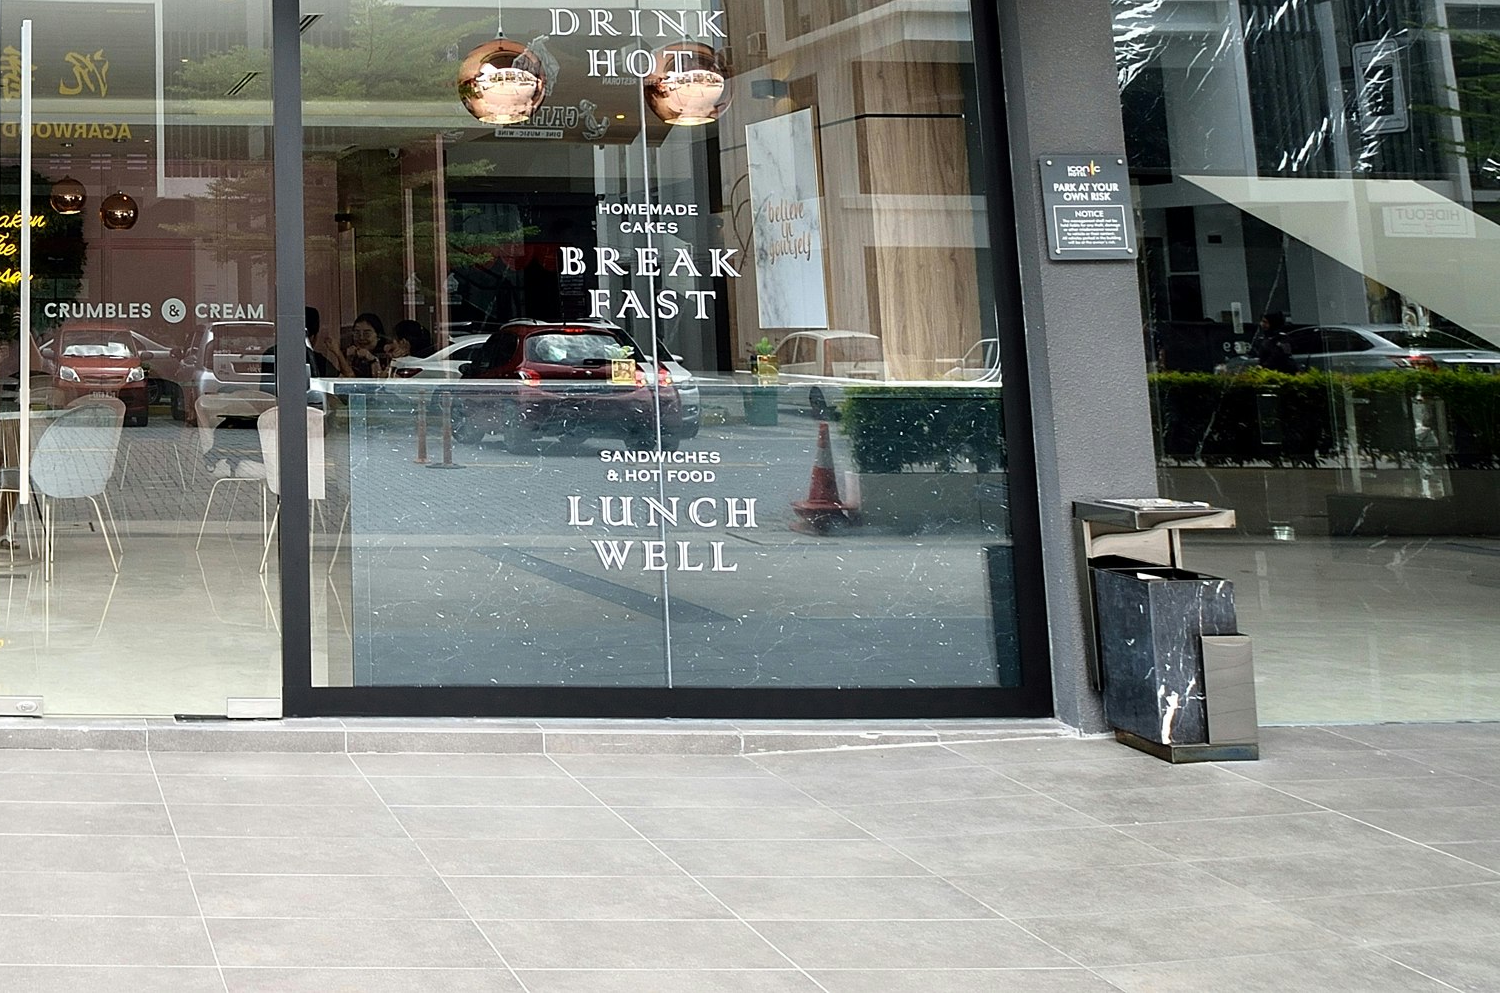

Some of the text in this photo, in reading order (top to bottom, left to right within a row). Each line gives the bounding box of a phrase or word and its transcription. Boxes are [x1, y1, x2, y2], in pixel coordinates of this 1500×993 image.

[549, 8, 728, 38] DRINK
[586, 49, 693, 78] HOT
[1053, 183, 1119, 192] PARK AT YOUR
[1063, 192, 1111, 201] OWN RISK
[598, 203, 699, 216] HOMEMADE
[768, 198, 805, 223] believe
[1075, 210, 1104, 218] NOTICE
[619, 221, 679, 234] CAKES
[769, 231, 811, 265] yourself
[560, 246, 742, 278] BREAK
[44, 302, 152, 320] CRUMBLES
[195, 303, 265, 320] CREAM
[588, 289, 717, 320] FAST
[600, 450, 721, 464] SANDWICHES
[625, 469, 661, 482] HOT
[667, 469, 716, 483] FOOD
[567, 495, 759, 528] LUNCH
[591, 540, 739, 572] WELL
